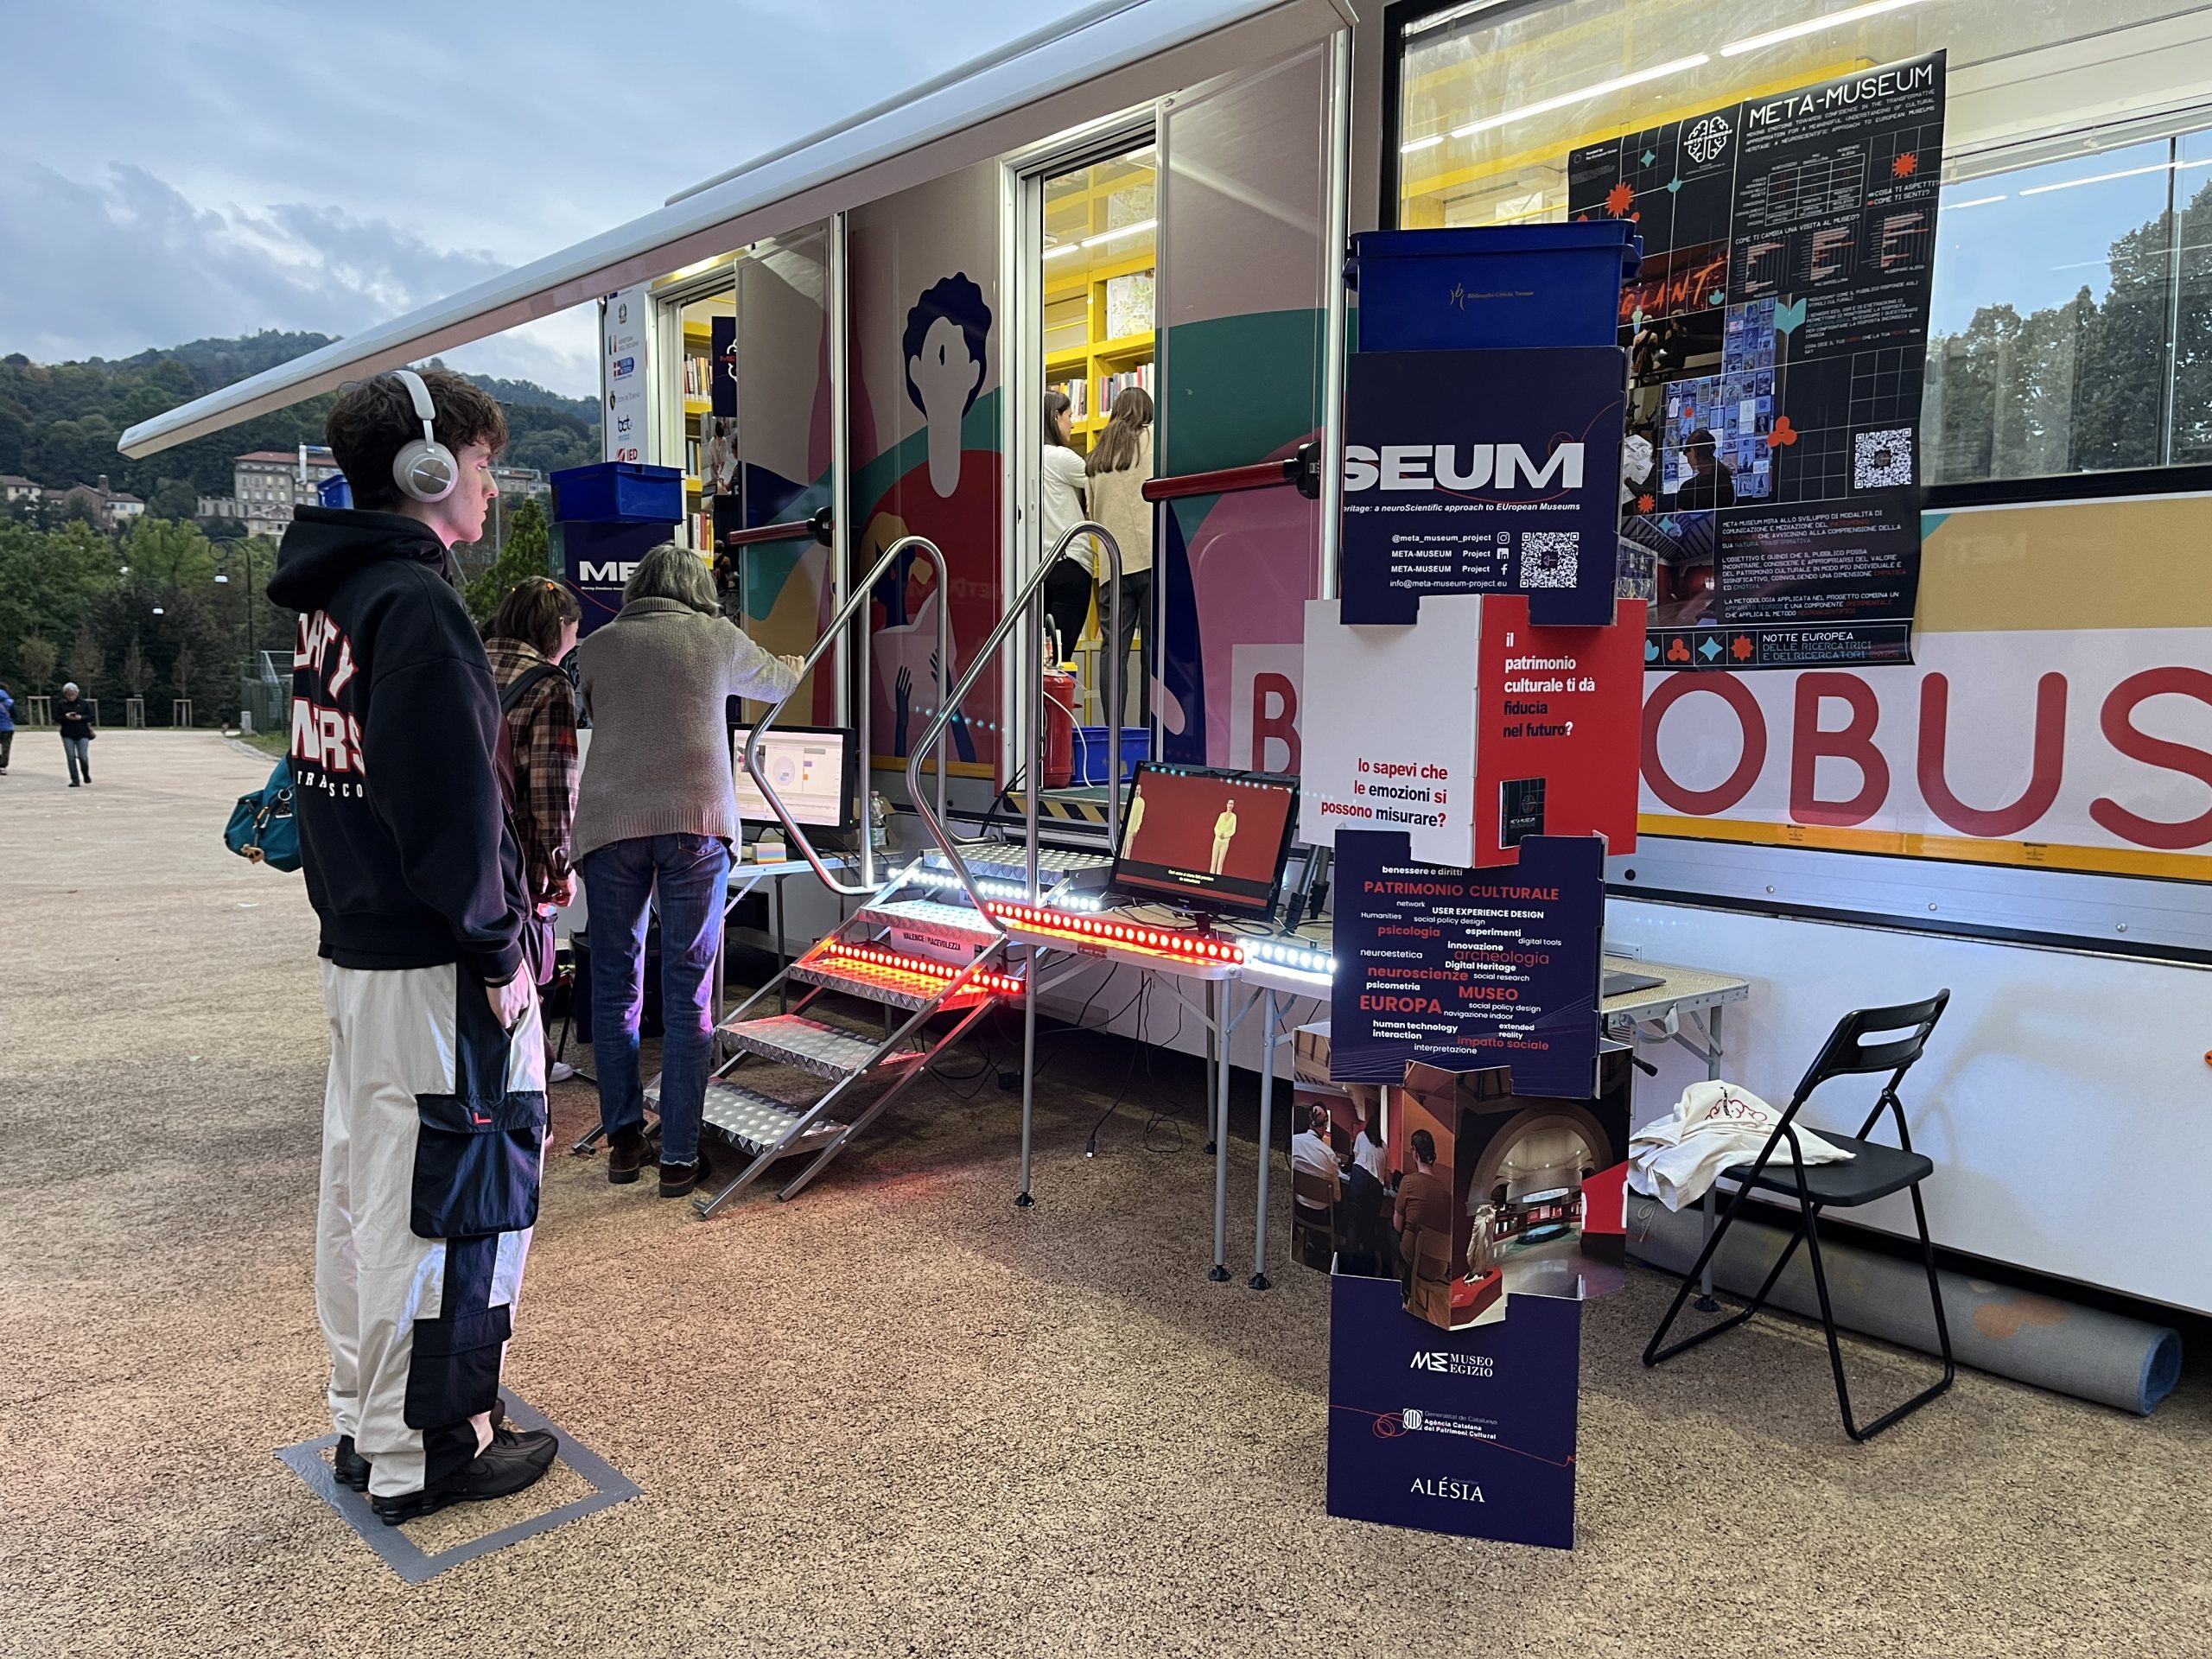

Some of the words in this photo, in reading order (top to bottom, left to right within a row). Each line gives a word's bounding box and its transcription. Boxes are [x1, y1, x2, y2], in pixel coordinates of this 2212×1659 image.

[1749, 63, 1933, 129] META-MUSEUM
[1874, 188, 1893, 198] COSA
[1904, 180, 1941, 192] ASPETTI?
[1874, 196, 1893, 206] COME
[1904, 189, 1930, 200] SENTI?
[1761, 229, 1783, 239] CAMBIA
[1784, 226, 1798, 235] UNA
[1800, 221, 1821, 232] VISITA
[1834, 213, 1860, 226] MUSEO?
[1344, 442, 1585, 492] SEUM
[1381, 503, 1443, 512] neuroScientific
[1445, 503, 1484, 513] approach
[1496, 503, 1537, 513] EUropean
[1539, 502, 1580, 511] Museums
[1723, 519, 1763, 528] META-MUSEUM
[1798, 514, 1830, 523] SVILUPPO
[1722, 525, 1769, 535] COMUNICAZIONE
[1827, 525, 1877, 534] COMPRENSIONE
[1391, 534, 1491, 543] @meta_museum_project
[1391, 550, 1452, 558] META-MUSEUM
[1462, 550, 1491, 559] Project
[1462, 565, 1491, 575] Project
[1389, 579, 1508, 589] info@meta-museum-project.eu
[1505, 632, 1514, 647] il
[1763, 633, 1798, 643] NOTTE
[1802, 632, 1854, 642] EUROPEA
[1763, 643, 1797, 652] DELLE
[1802, 640, 1872, 651] RICERCATRICI
[1763, 652, 1770, 661] E
[1794, 650, 1866, 660] RICERCATORI
[1504, 655, 1577, 673] patrimonio
[1504, 677, 1563, 692] culturale
[1567, 677, 1576, 691] ti
[1579, 677, 1595, 691] dà
[1503, 701, 1548, 715] fiducia
[1503, 723, 1522, 737] nel
[1526, 721, 1573, 737] futuro?
[1373, 761, 1417, 781] sapevi
[1421, 764, 1448, 779] che
[1354, 780, 1365, 794] le
[1369, 782, 1430, 802] emozioni
[1433, 787, 1447, 804] si
[1321, 802, 1372, 817] possono
[1376, 807, 1446, 827] misurare?
[1382, 866, 1429, 875] benessere
[1438, 867, 1463, 876] diritti
[1364, 881, 1464, 896] PATRIMONIO
[1469, 886, 1560, 900] CULTURALE
[1456, 908, 1509, 918] EXPERIENCE
[1510, 910, 1544, 918] DESIGN
[1437, 916, 1459, 925] policy
[1460, 917, 1485, 926] design
[1377, 925, 1440, 938] psicologia
[1465, 927, 1522, 938] esperimenti
[902, 931, 925, 943] VALENCE
[927, 938, 961, 950] PIACEVOLEZZA
[1447, 941, 1503, 951] innovazione
[1518, 938, 1542, 946] digital
[1360, 949, 1423, 959] neuroestetica
[1454, 948, 1549, 967] archeologia
[1445, 960, 1475, 971] Digital
[1477, 962, 1516, 973] Heritage
[1368, 967, 1469, 981] neuroscienze
[1366, 981, 1421, 991] psicometria
[1459, 986, 1518, 1001] MUSEO
[1360, 995, 1442, 1014] EUROPA
[1469, 1001, 1491, 1010] social
[1491, 1002, 1514, 1013] policy
[1516, 1004, 1541, 1014] design
[1443, 1010, 1488, 1020] navigazione
[1372, 1020, 1405, 1028] human
[1407, 1021, 1459, 1034] technology
[1499, 1022, 1535, 1031] extended
[1372, 1029, 1422, 1039] interaction
[1498, 1031, 1523, 1039] reality
[1414, 1043, 1478, 1055] interpretazione
[1458, 1036, 1504, 1049] impatto
[1507, 1039, 1549, 1050] sociale
[1450, 1353, 1493, 1367] MUSEO
[1450, 1364, 1493, 1377] EGIZIO
[1424, 1419, 1451, 1428] Agència
[1452, 1422, 1482, 1431] Catalana
[1468, 1415, 1497, 1426] Catalunya
[1436, 1427, 1468, 1436] Patrimoni
[1469, 1431, 1496, 1440] Cultural
[1411, 1477, 1484, 1503] ALÉSIA
